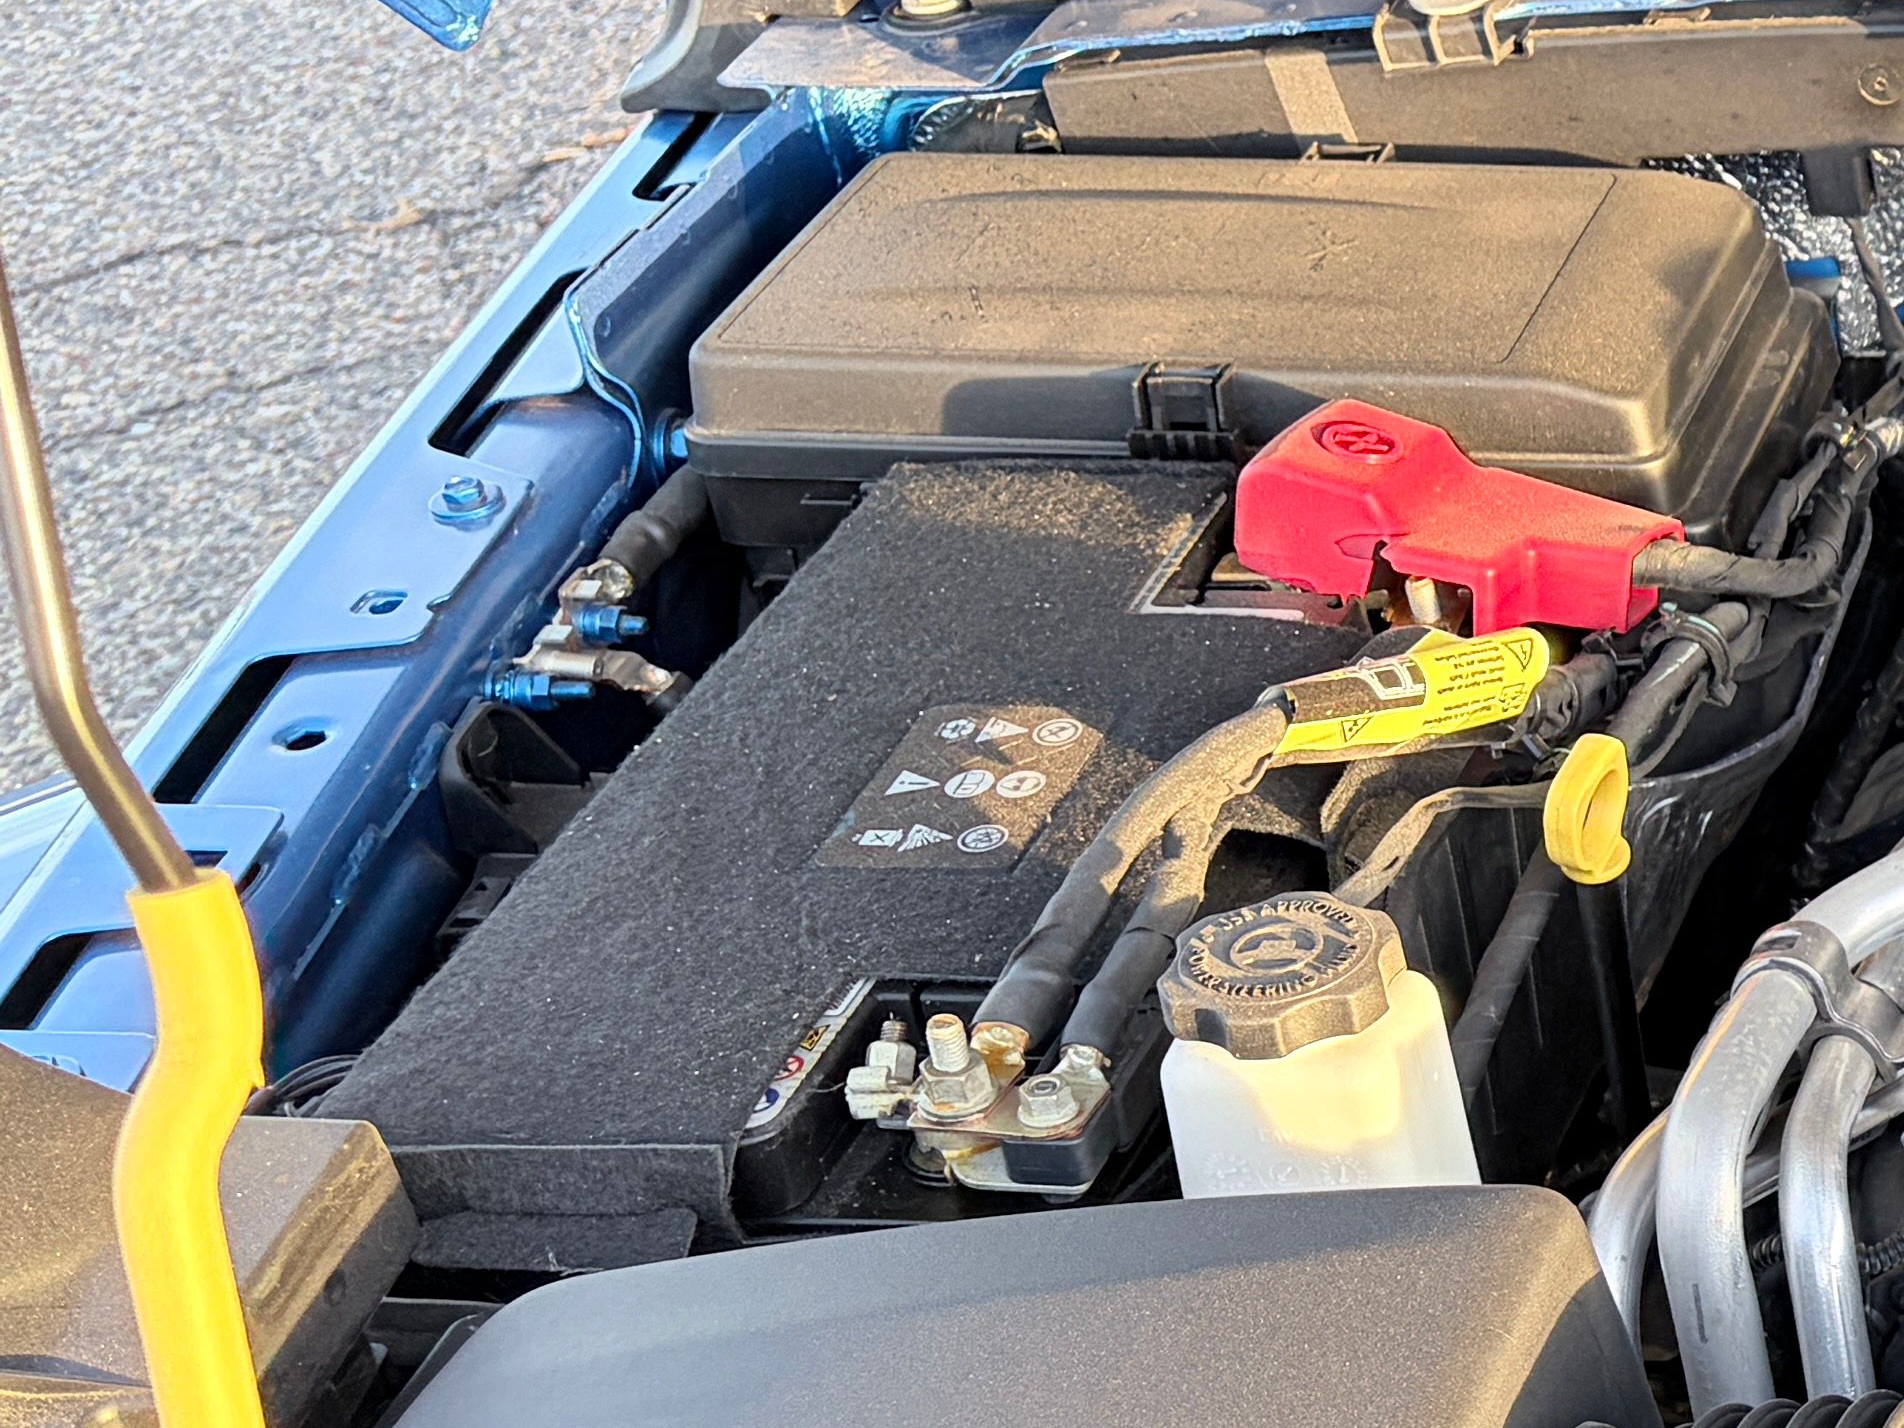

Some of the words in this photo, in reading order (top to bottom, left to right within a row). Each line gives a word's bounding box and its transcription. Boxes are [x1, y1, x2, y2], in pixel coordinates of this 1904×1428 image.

[1260, 899, 1357, 930] APPROVED
[1187, 946, 1224, 990] POWER
[1220, 971, 1320, 998] STEERING
